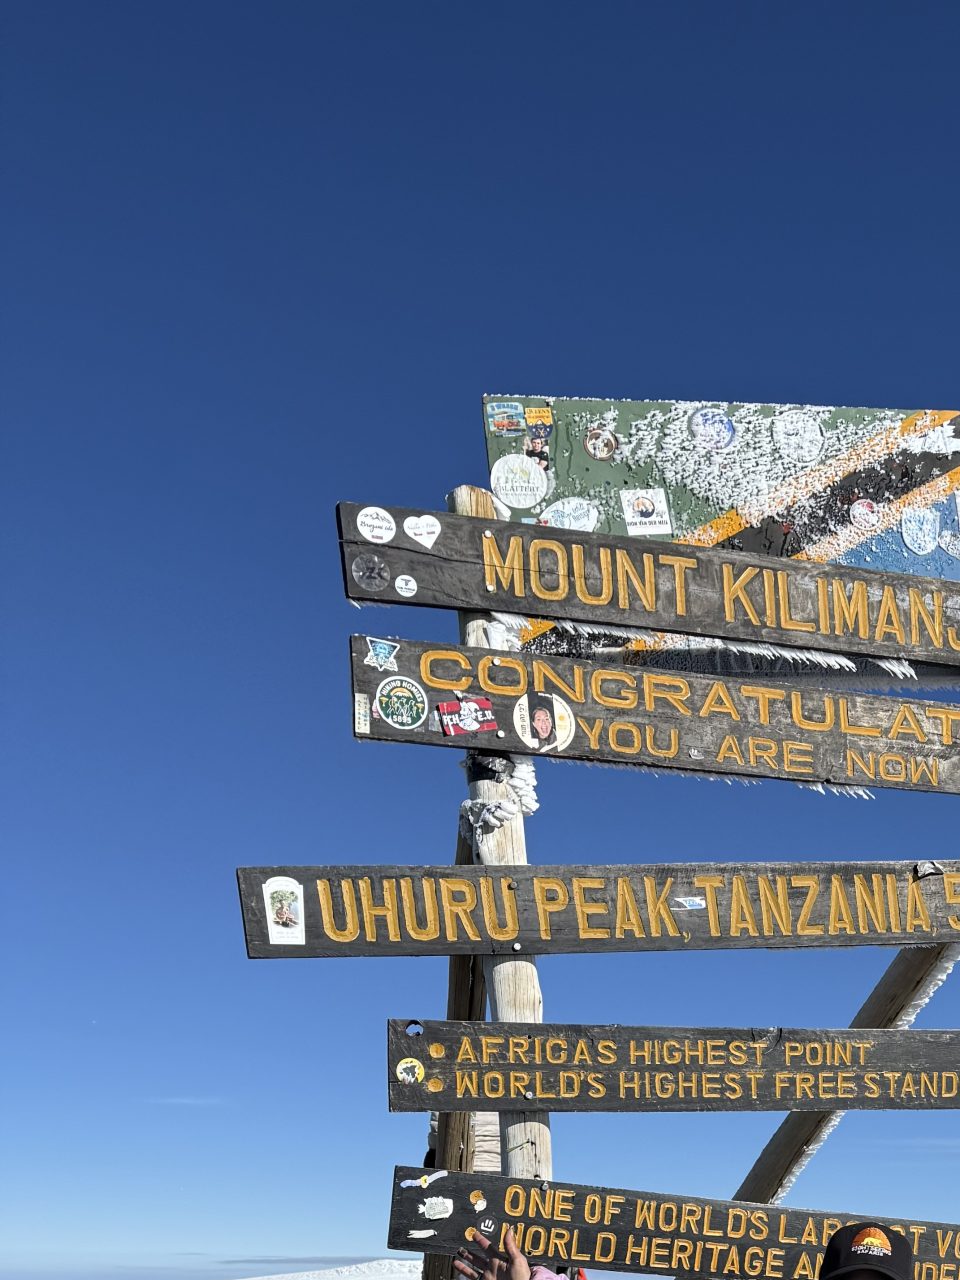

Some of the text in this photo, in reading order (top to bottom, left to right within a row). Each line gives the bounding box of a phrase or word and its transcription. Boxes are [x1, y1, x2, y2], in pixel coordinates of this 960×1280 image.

[482, 535, 698, 617] MOUNT
[392, 715, 412, 724] 5895
[577, 717, 680, 759] YOU
[715, 736, 815, 774] ARE
[846, 748, 940, 787] NOW
[316, 876, 520, 942] UHURU
[629, 1039, 768, 1066] HIGHEST
[785, 1040, 874, 1066] POINT
[456, 1070, 607, 1099] WORLD'S
[619, 1071, 764, 1099] HIGHEST
[504, 1184, 576, 1222] ONE
[584, 1193, 625, 1225] OF
[779, 1213, 927, 1256] LART
[625, 1234, 785, 1278] HERITAGE
